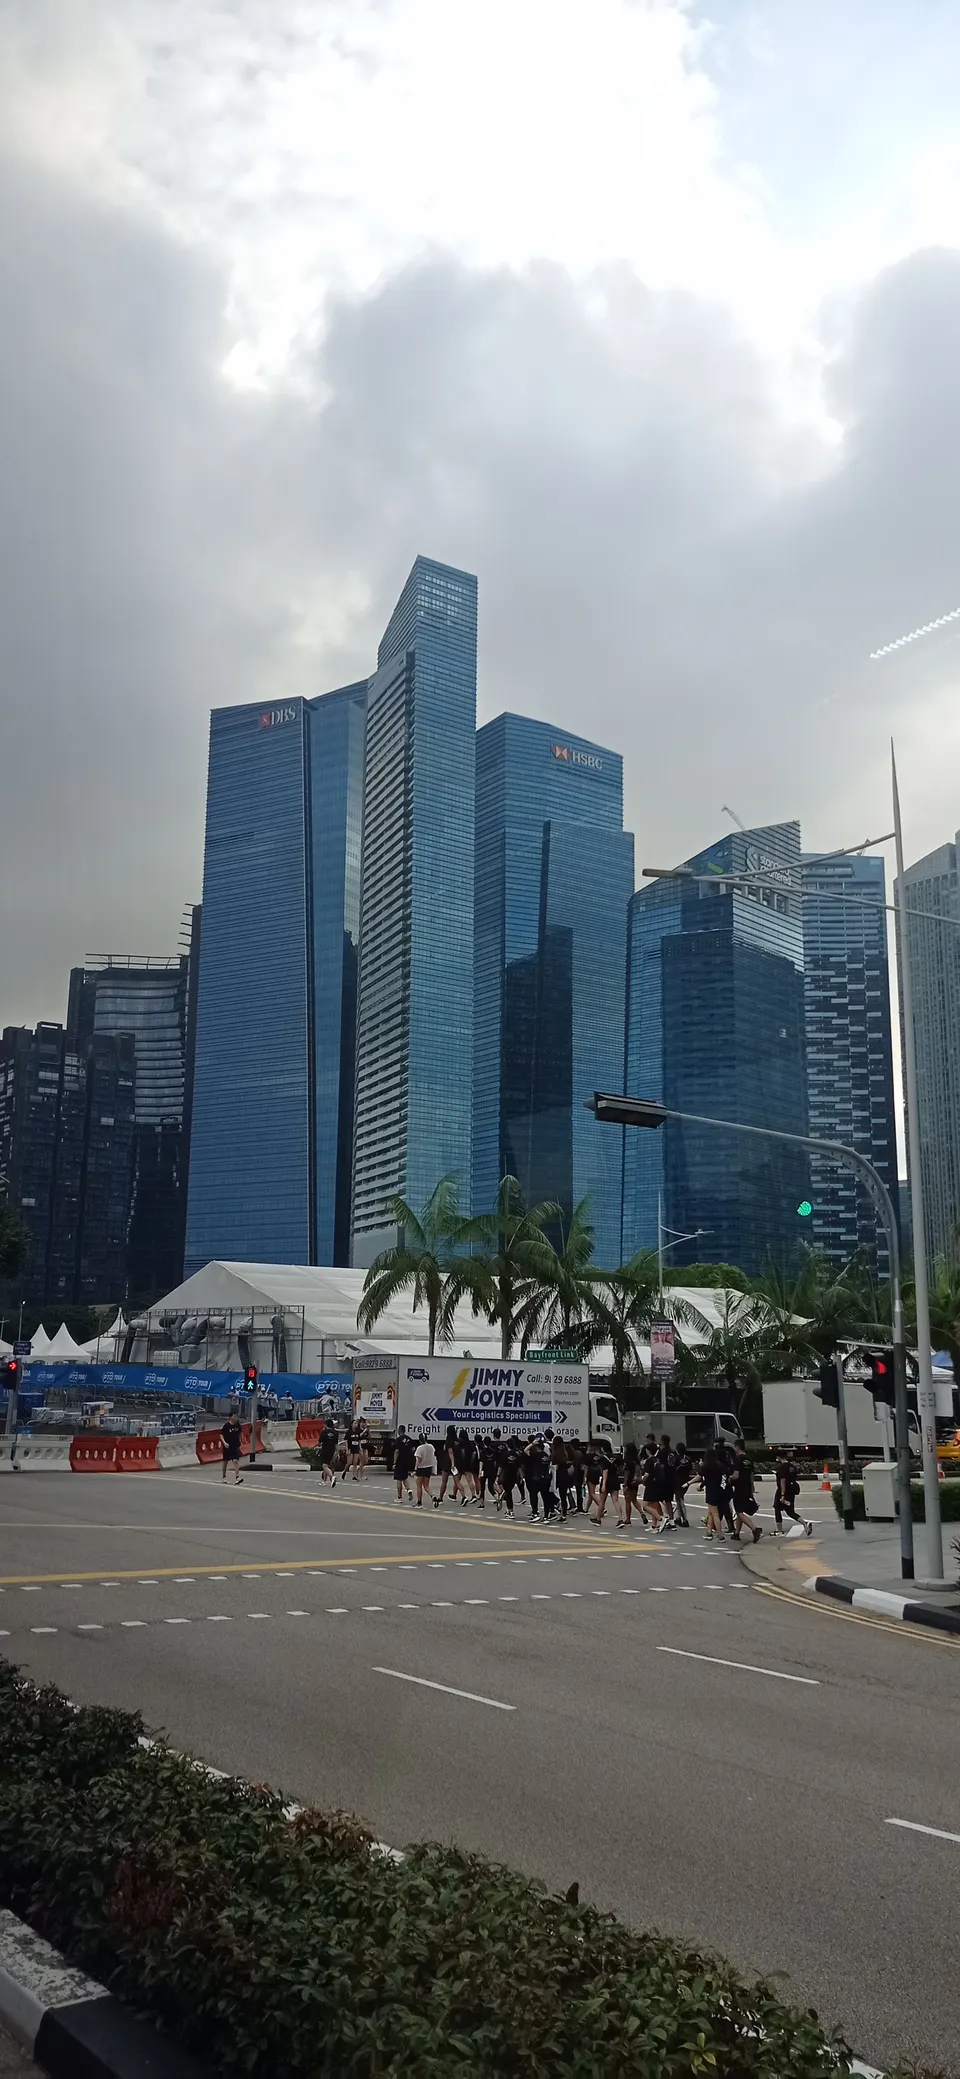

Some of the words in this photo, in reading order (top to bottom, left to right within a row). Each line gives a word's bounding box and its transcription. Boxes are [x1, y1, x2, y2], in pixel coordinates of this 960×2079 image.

[271, 705, 296, 726] DBS
[572, 751, 603, 770] HSBC
[529, 1350, 559, 1359] Bayfront
[560, 1350, 575, 1358] Link
[469, 1367, 525, 1389] JIMMY
[526, 1374, 543, 1383] Call:
[564, 1375, 582, 1385] 6888
[464, 1389, 524, 1408] MOVER
[452, 1410, 470, 1418] Your
[471, 1411, 504, 1420] Logistics
[505, 1411, 540, 1420] Specialist
[407, 1423, 436, 1434] Freight
[452, 1425, 494, 1436] ransport
